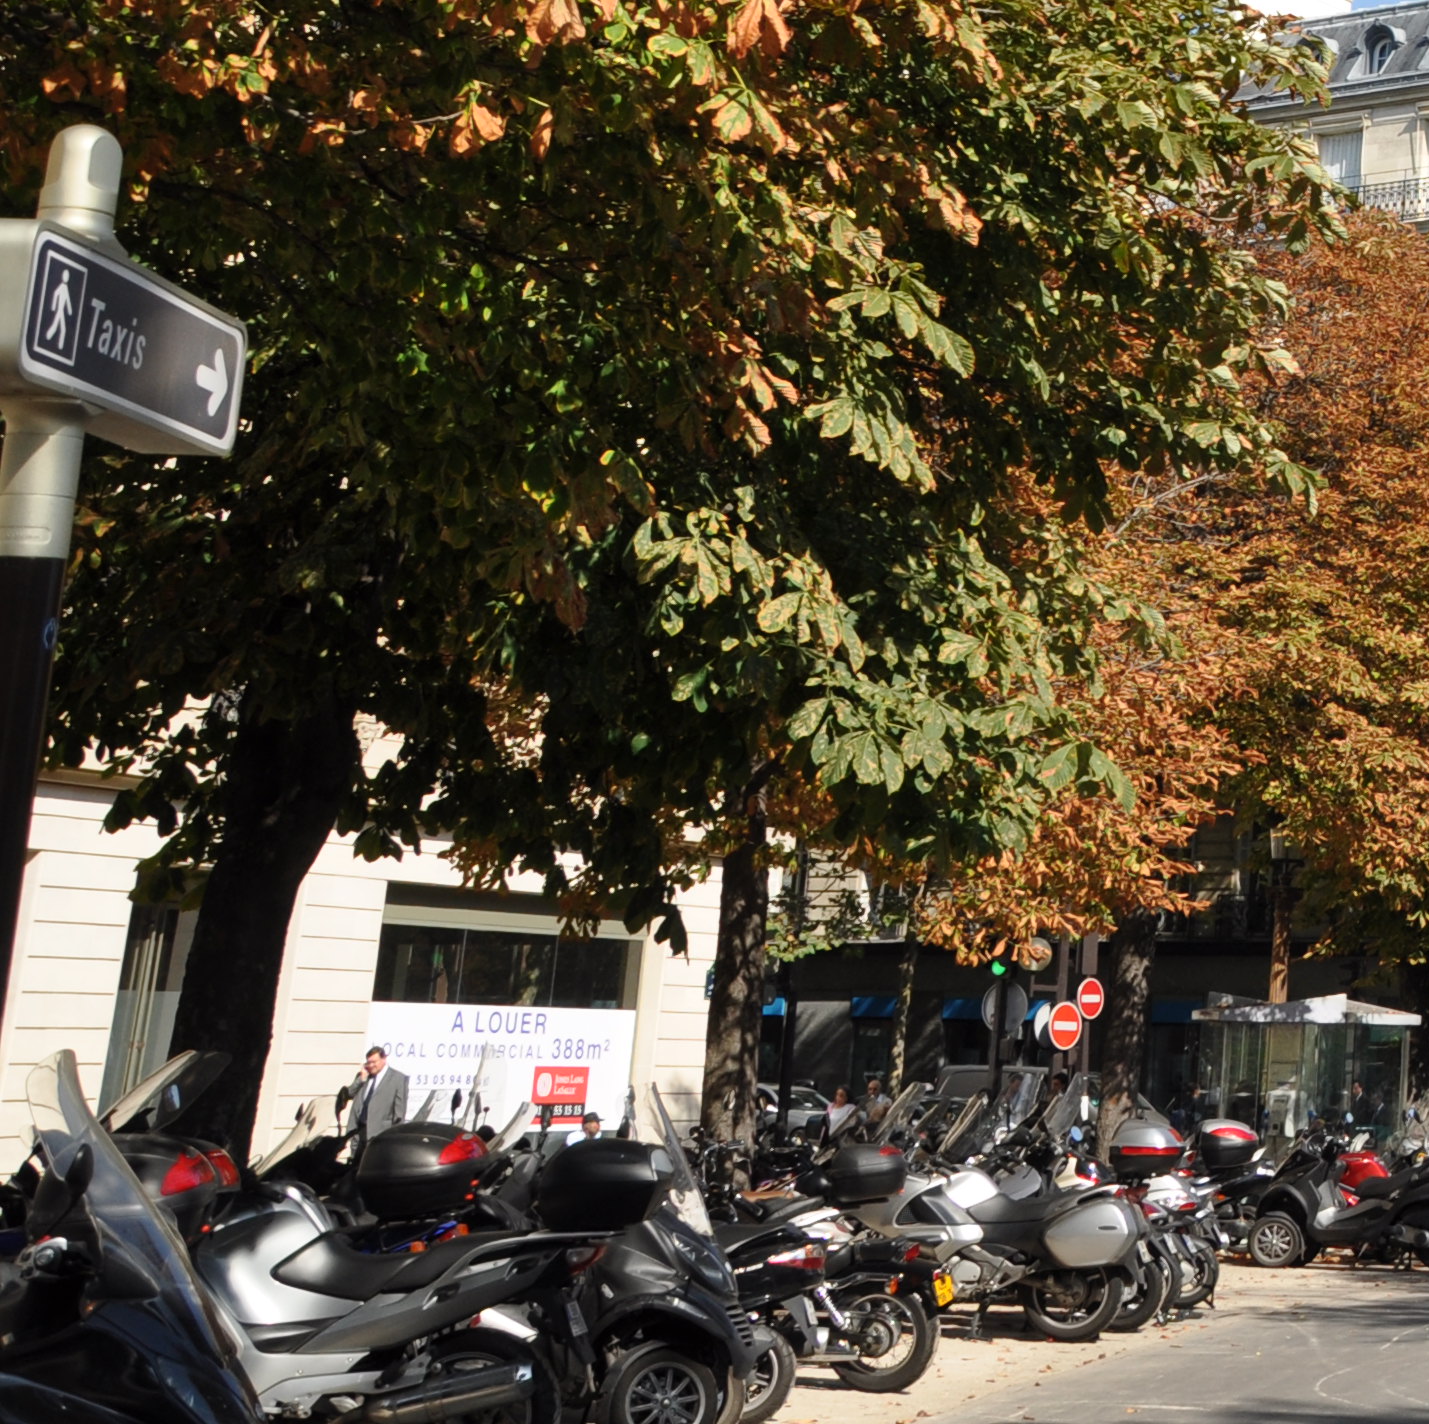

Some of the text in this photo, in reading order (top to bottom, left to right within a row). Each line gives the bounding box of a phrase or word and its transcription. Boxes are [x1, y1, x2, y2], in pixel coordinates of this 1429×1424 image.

[87, 297, 147, 370] Taxis
[451, 1010, 547, 1035] A LOUER
